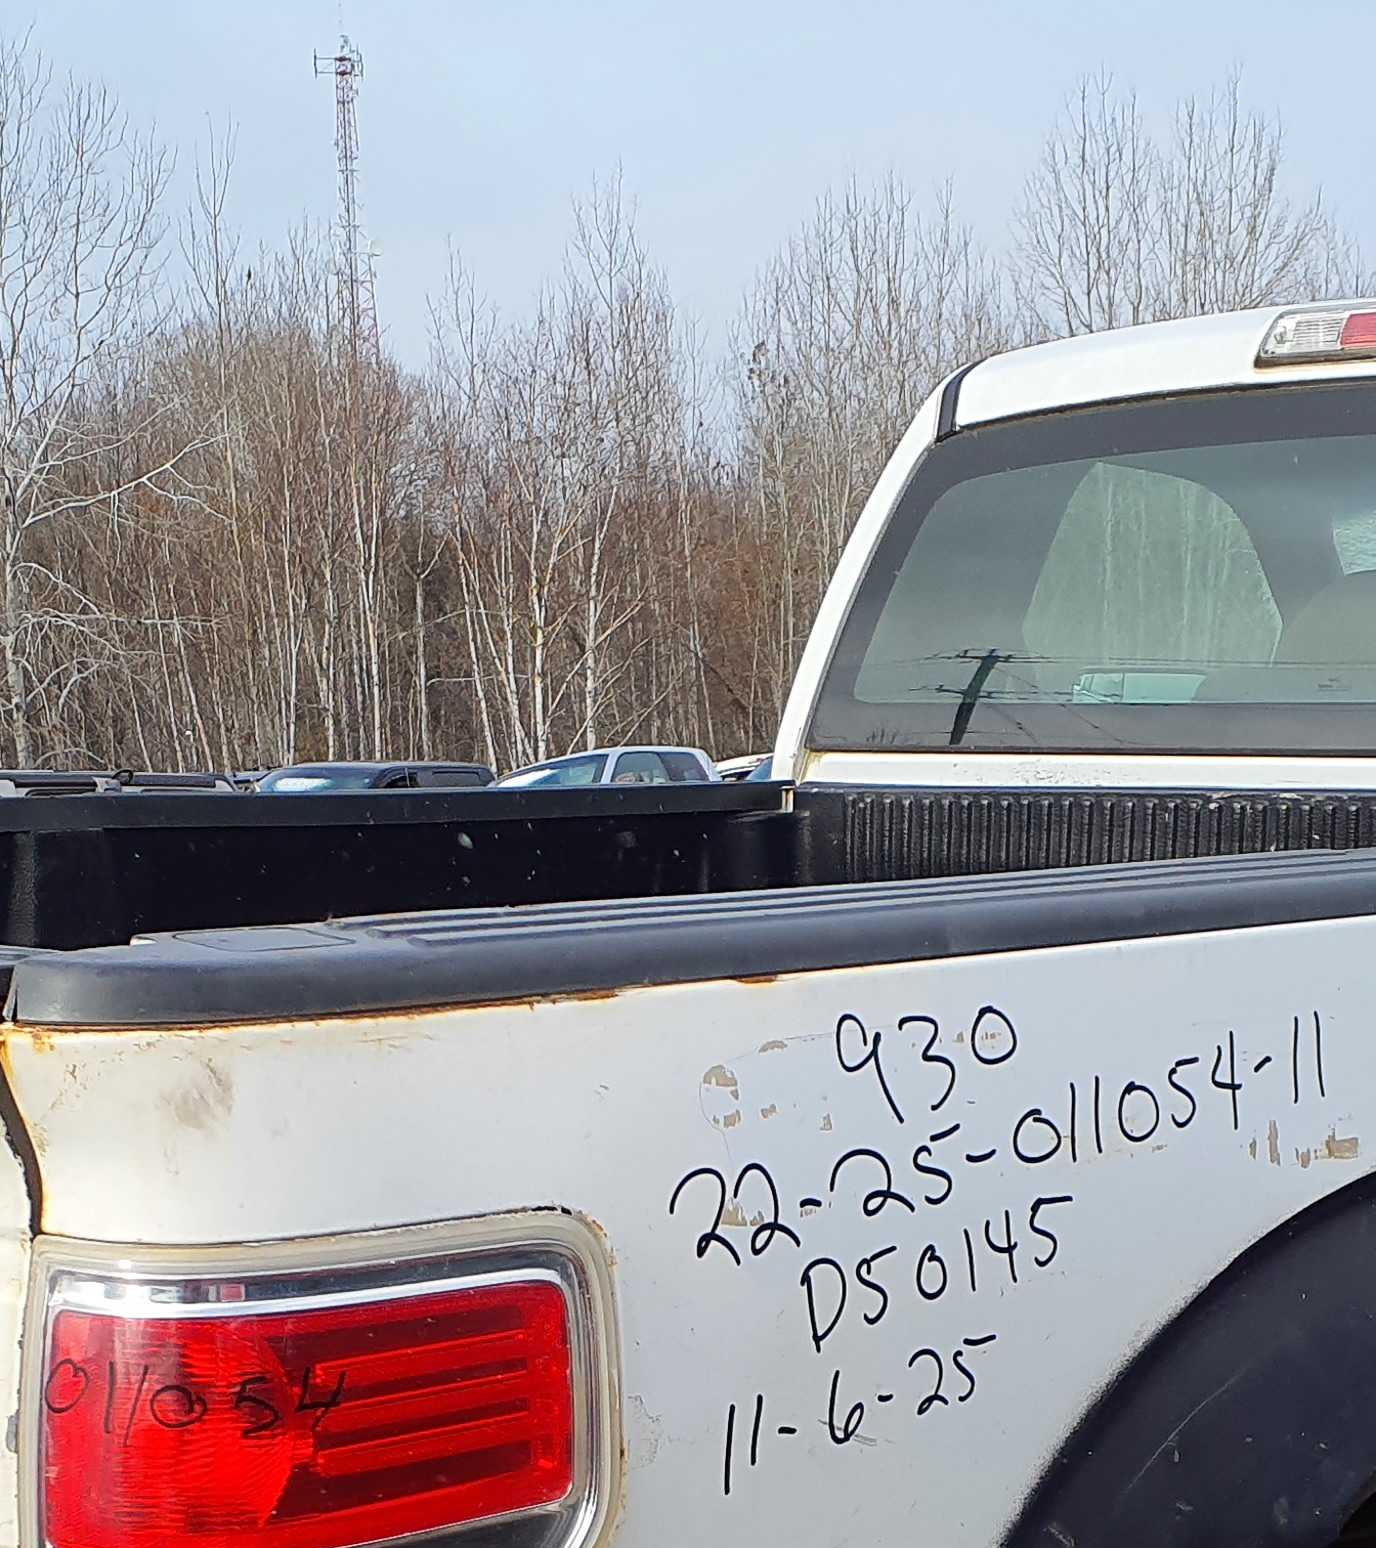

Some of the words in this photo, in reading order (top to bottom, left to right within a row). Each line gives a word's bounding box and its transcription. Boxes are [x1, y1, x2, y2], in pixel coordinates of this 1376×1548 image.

[834, 1005, 1019, 1124] 930
[668, 1010, 1326, 1267] 22-25-011054-11
[43, 1357, 348, 1446] 011054
[723, 1333, 998, 1497] 11-6-25
